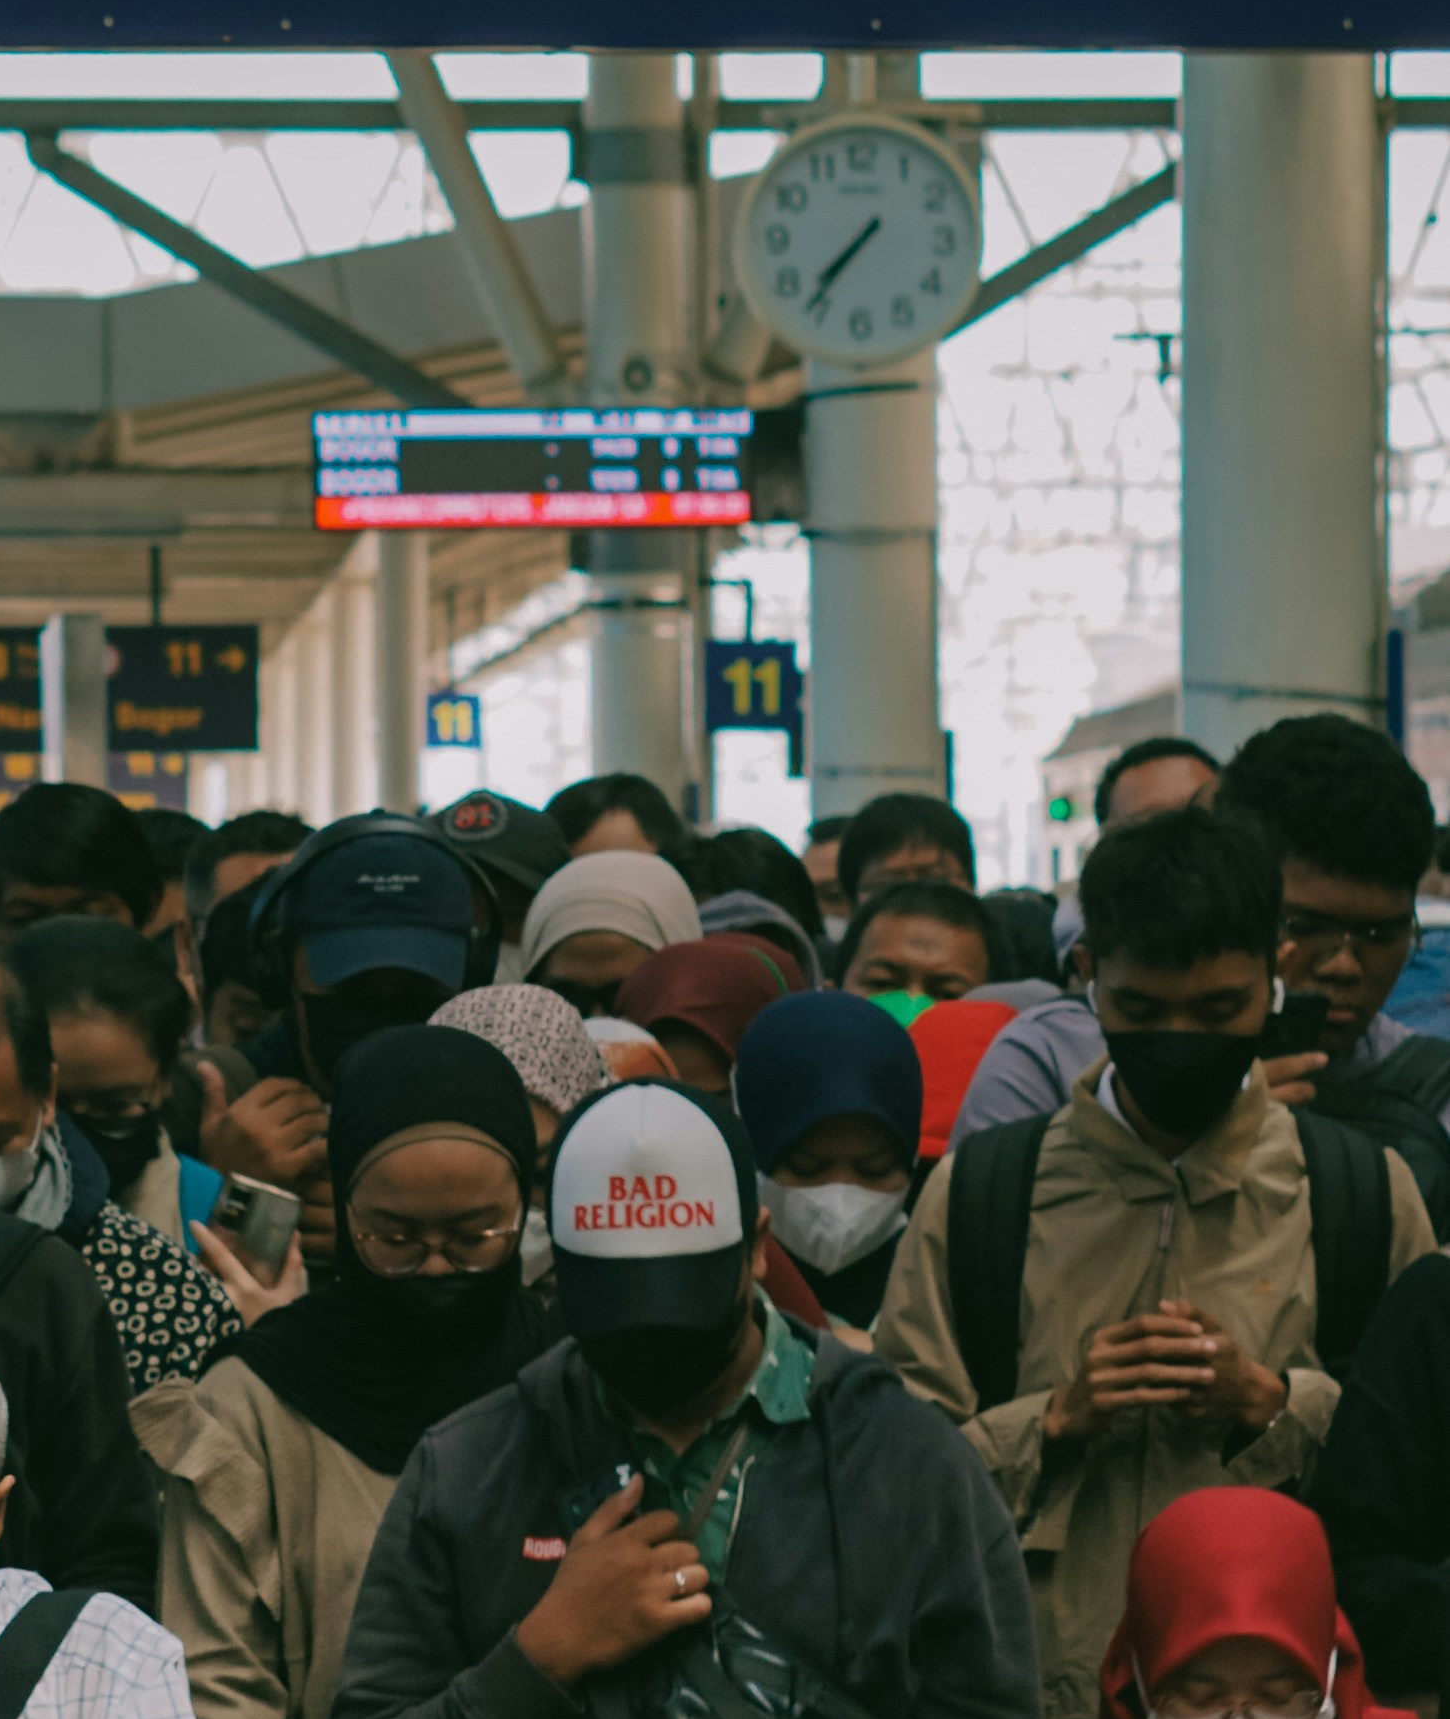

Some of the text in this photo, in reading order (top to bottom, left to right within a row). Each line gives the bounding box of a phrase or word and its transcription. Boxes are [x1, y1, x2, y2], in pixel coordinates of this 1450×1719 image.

[810, 154, 836, 181] 11
[846, 140, 877, 171] 12
[899, 155, 909, 180] 1
[776, 183, 809, 214] 10
[923, 182, 948, 213] 2
[932, 225, 957, 257] 3
[920, 266, 942, 296] 4
[166, 641, 203, 679] 11
[722, 657, 781, 716] 11
[433, 701, 472, 742] 11
[608, 1173, 677, 1202] BAD
[573, 1200, 715, 1231] RELIGION
